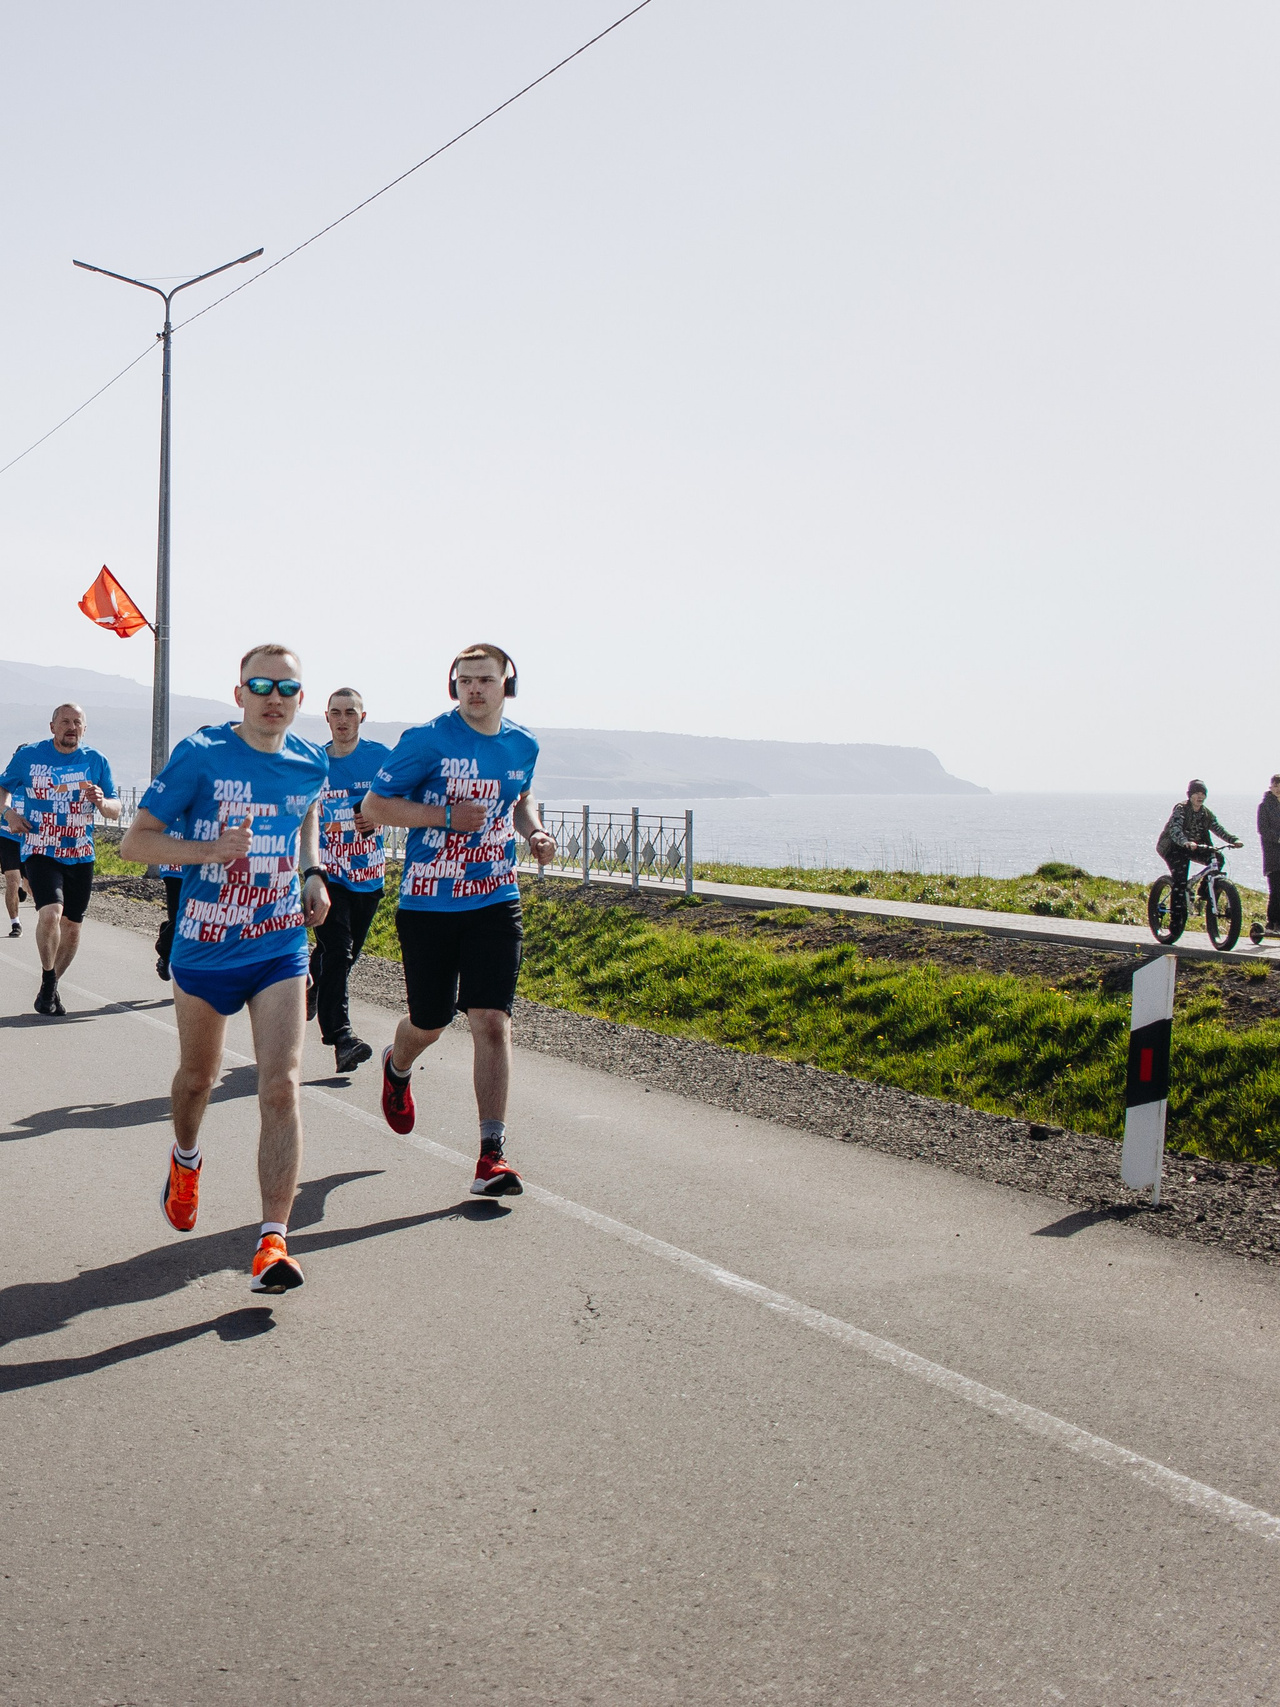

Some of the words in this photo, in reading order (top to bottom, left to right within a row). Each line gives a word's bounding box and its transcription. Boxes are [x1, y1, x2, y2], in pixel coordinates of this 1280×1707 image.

[29, 764, 53, 776] 2024
[440, 757, 479, 779] 2024
[32, 776, 54, 789] #МЕ
[214, 779, 253, 802] 2024
[446, 778, 501, 800] #МЕЧТА
[30, 810, 57, 825] #ЗАБЕГ
[218, 801, 278, 822] #МЕЧТА
[334, 807, 355, 820] 200
[193, 818, 228, 841] #ЗА
[250, 835, 286, 854] 0014
[435, 844, 505, 864] #ОРДОСТЬ
[348, 863, 385, 883] #ЕДИНСТ
[401, 876, 439, 897] ЗАБЕГ
[178, 916, 228, 942] #ЗАБЕГ
